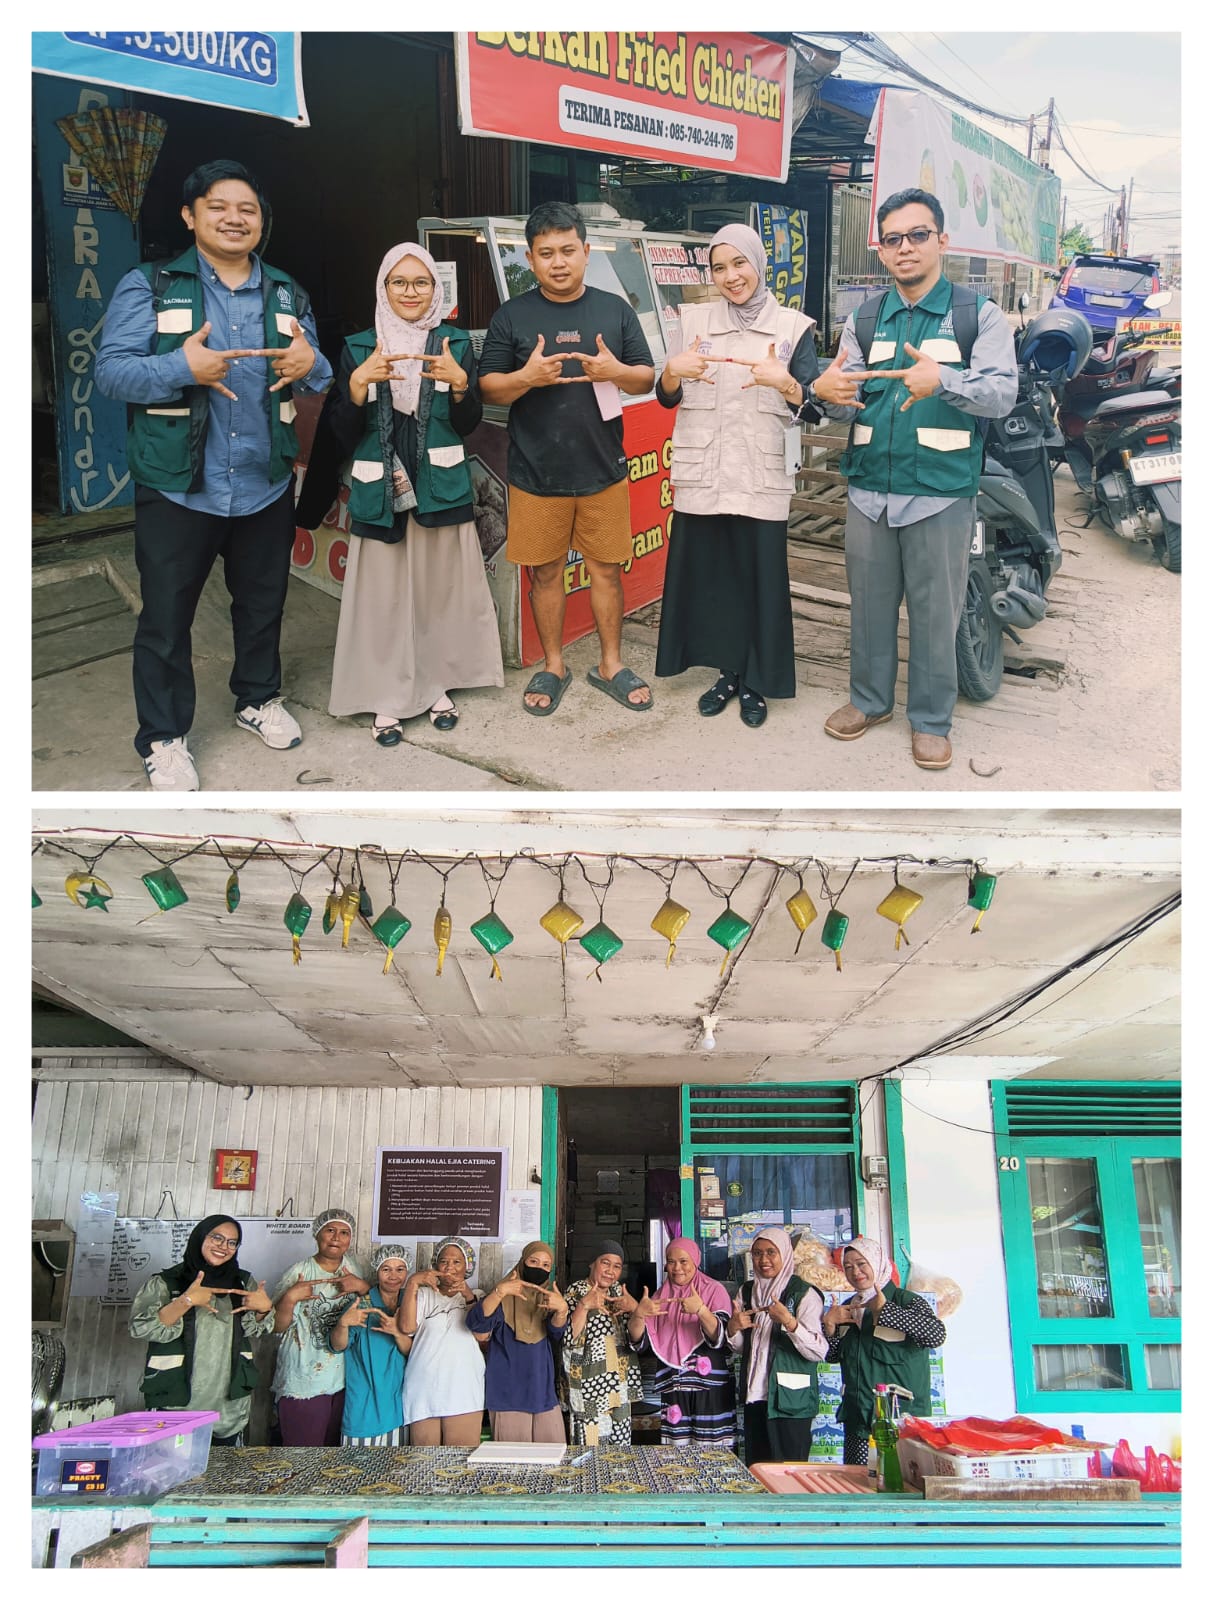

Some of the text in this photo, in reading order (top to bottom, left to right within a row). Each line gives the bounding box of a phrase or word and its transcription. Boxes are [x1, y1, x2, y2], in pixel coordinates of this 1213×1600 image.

[616, 32, 687, 98] Fried
[693, 43, 782, 121] Chicken
[565, 99, 611, 127] TERIMA
[613, 110, 664, 138] PESANAN
[669, 121, 734, 151] 085-740-244-786
[762, 208, 772, 235] TEH
[787, 208, 804, 285] YAM
[660, 479, 672, 508] &
[462, 1158, 496, 1166] CATERING
[1000, 1156, 1020, 1171] 20
